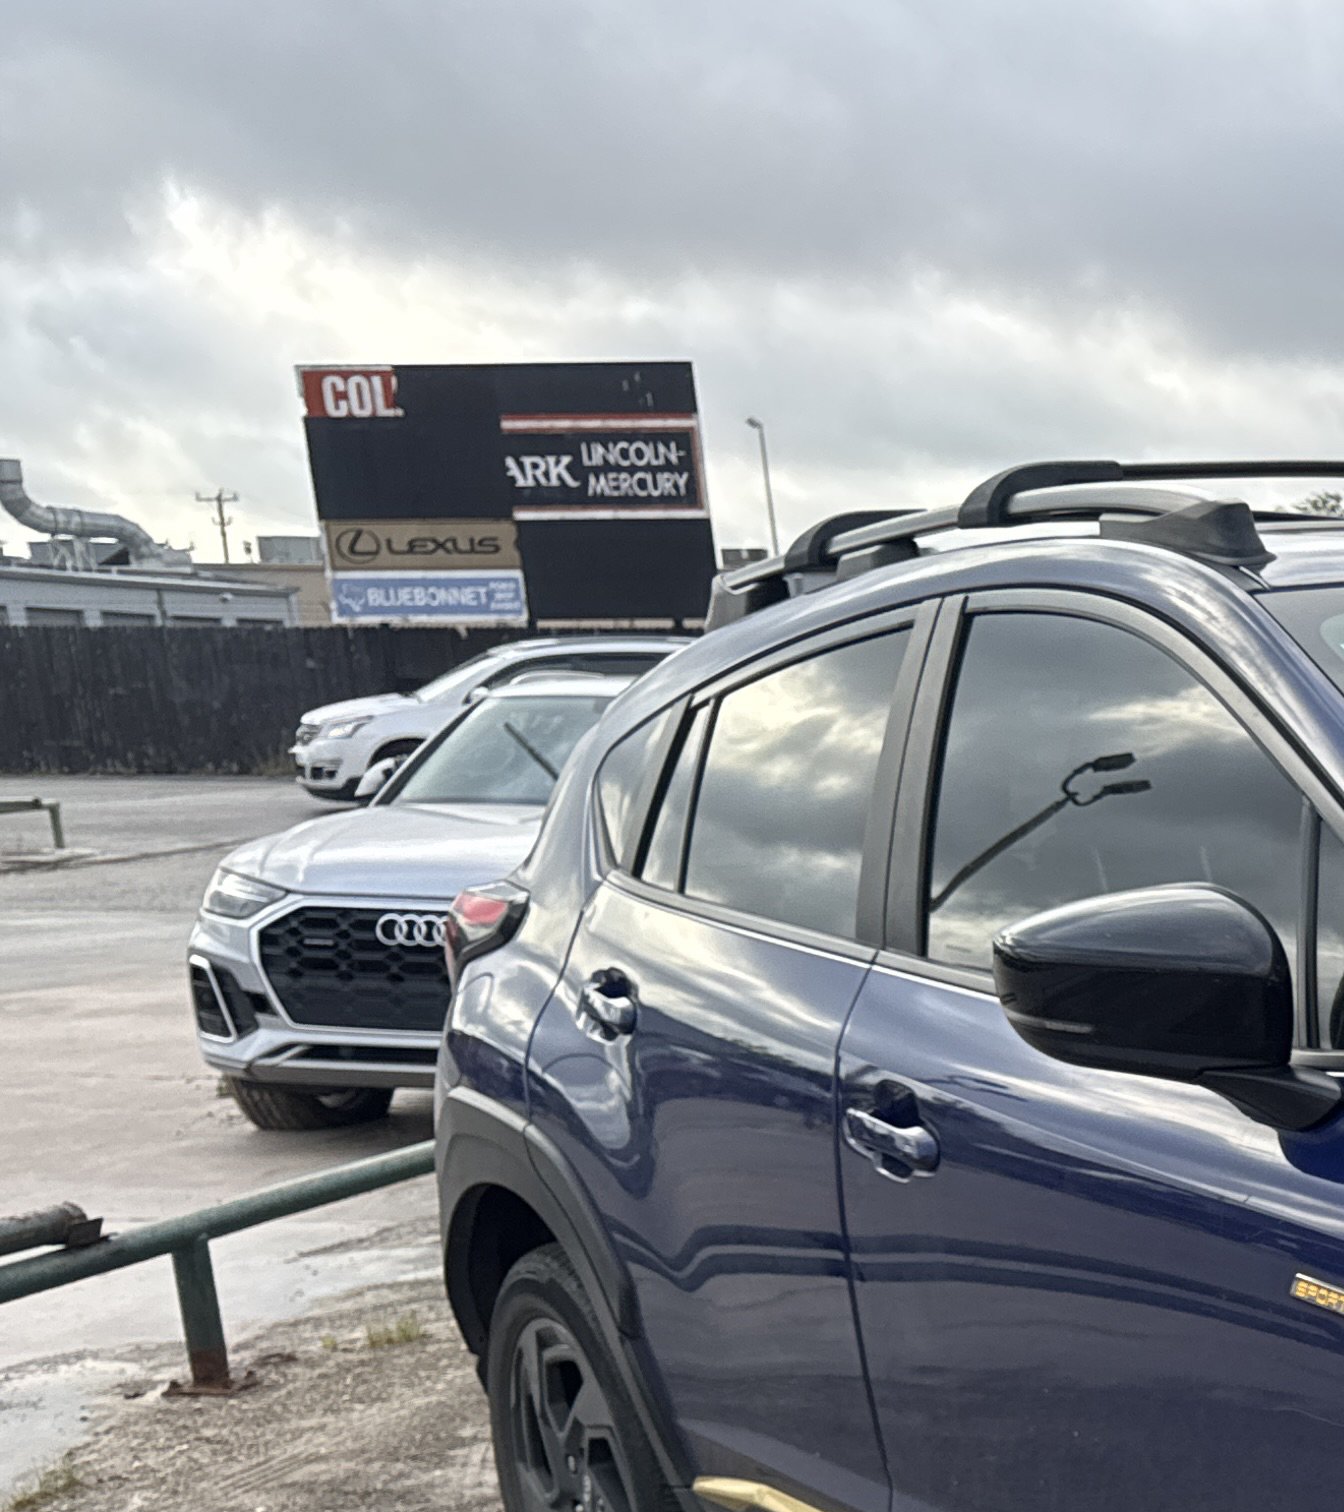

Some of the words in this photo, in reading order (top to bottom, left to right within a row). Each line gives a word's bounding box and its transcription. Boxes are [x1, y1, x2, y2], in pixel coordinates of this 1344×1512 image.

[321, 374, 405, 418] COL
[586, 471, 690, 497] MERCURY
[385, 536, 502, 555] LEXUS
[366, 585, 488, 607] BLUEBONNET
